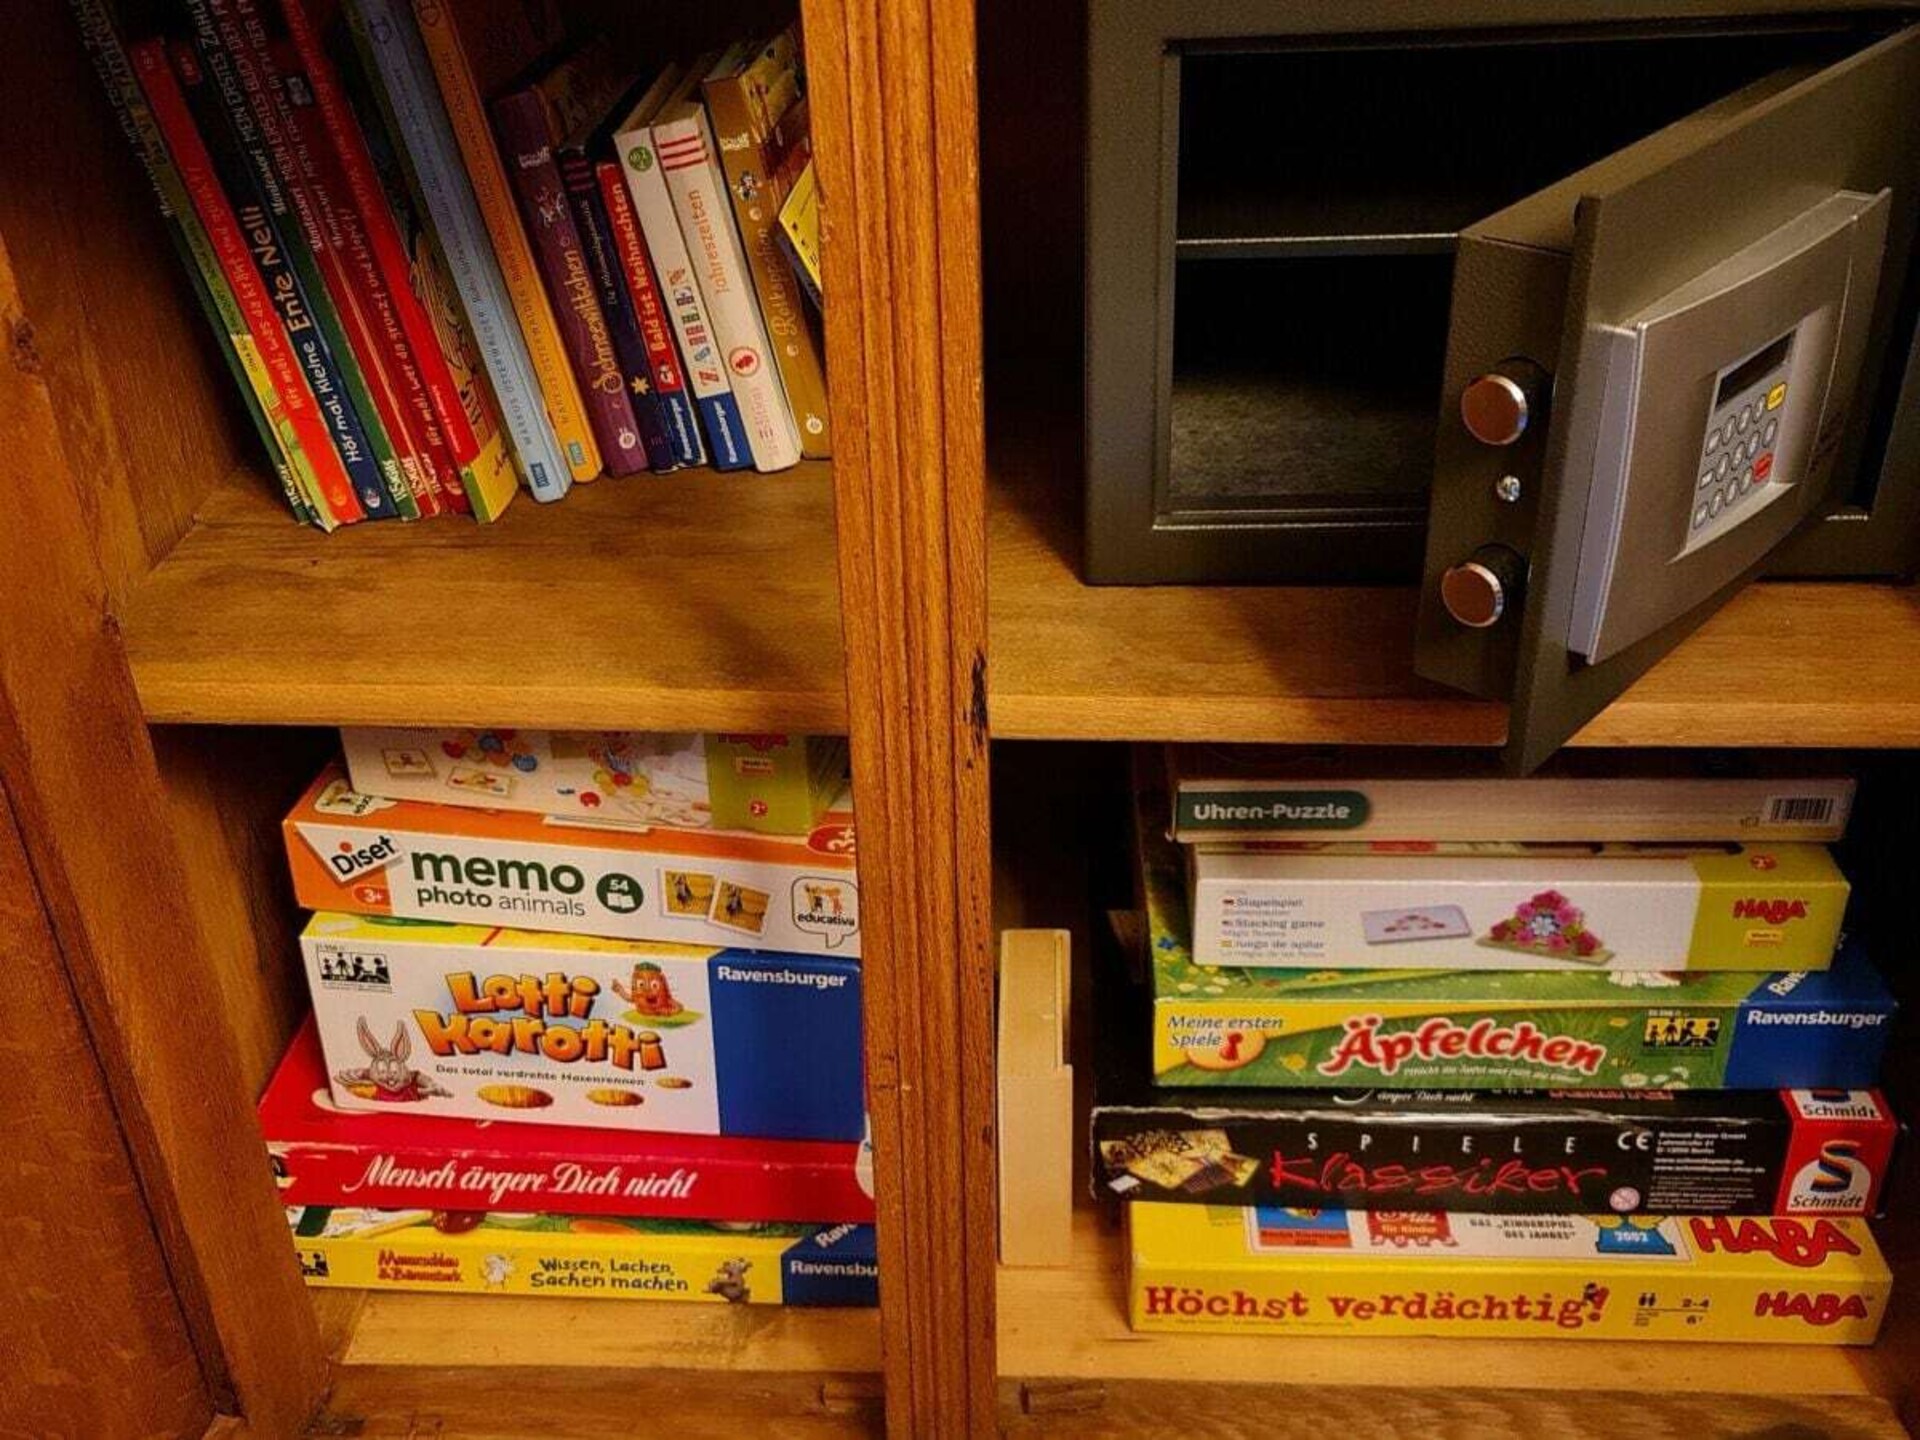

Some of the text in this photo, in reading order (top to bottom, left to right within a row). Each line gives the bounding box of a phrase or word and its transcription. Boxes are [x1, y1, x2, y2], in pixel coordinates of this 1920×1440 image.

[235, 200, 284, 270] Nelli
[605, 181, 650, 290] Weihnachten
[683, 187, 731, 296] Jahreszeiten
[266, 269, 312, 335] Ente
[635, 290, 658, 317] ist
[569, 248, 625, 395] Schneewittchen
[642, 317, 667, 352] Bald
[664, 263, 720, 387] ZAHLEN
[321, 392, 352, 433] mal,
[336, 429, 364, 465] Hör
[1192, 803, 1352, 822] Uhren-Puzzle
[331, 835, 396, 875] Diset
[411, 852, 585, 894] memo
[417, 885, 586, 917] photo animals
[797, 912, 855, 926] educativa
[1732, 898, 1806, 925] HABA
[446, 971, 600, 1020] Lotti
[717, 966, 847, 989] Ravensburger
[1166, 1014, 1284, 1030] Meine ersten
[1747, 1010, 1887, 1028] Ravensburger
[415, 1009, 668, 1072] Karotti
[1169, 1031, 1222, 1048] Spiele
[1318, 1014, 1606, 1075] Äpfelchen
[436, 1063, 459, 1075] Das
[463, 1064, 494, 1076] total
[1803, 1104, 1878, 1119] Schmidt
[342, 1154, 698, 1204] Mensch ärgere Dich nicht
[1270, 1150, 1607, 1194] Klassiker
[1790, 1194, 1864, 1211] Schmidt
[1690, 1217, 1862, 1268] HABA
[530, 1272, 688, 1292] Sachen machen
[538, 1258, 675, 1276] Wissen, Lachen,
[1145, 1286, 1309, 1320] Höchst
[1328, 1285, 1610, 1330] verdächtig!
[1755, 1291, 1868, 1327] HABA
